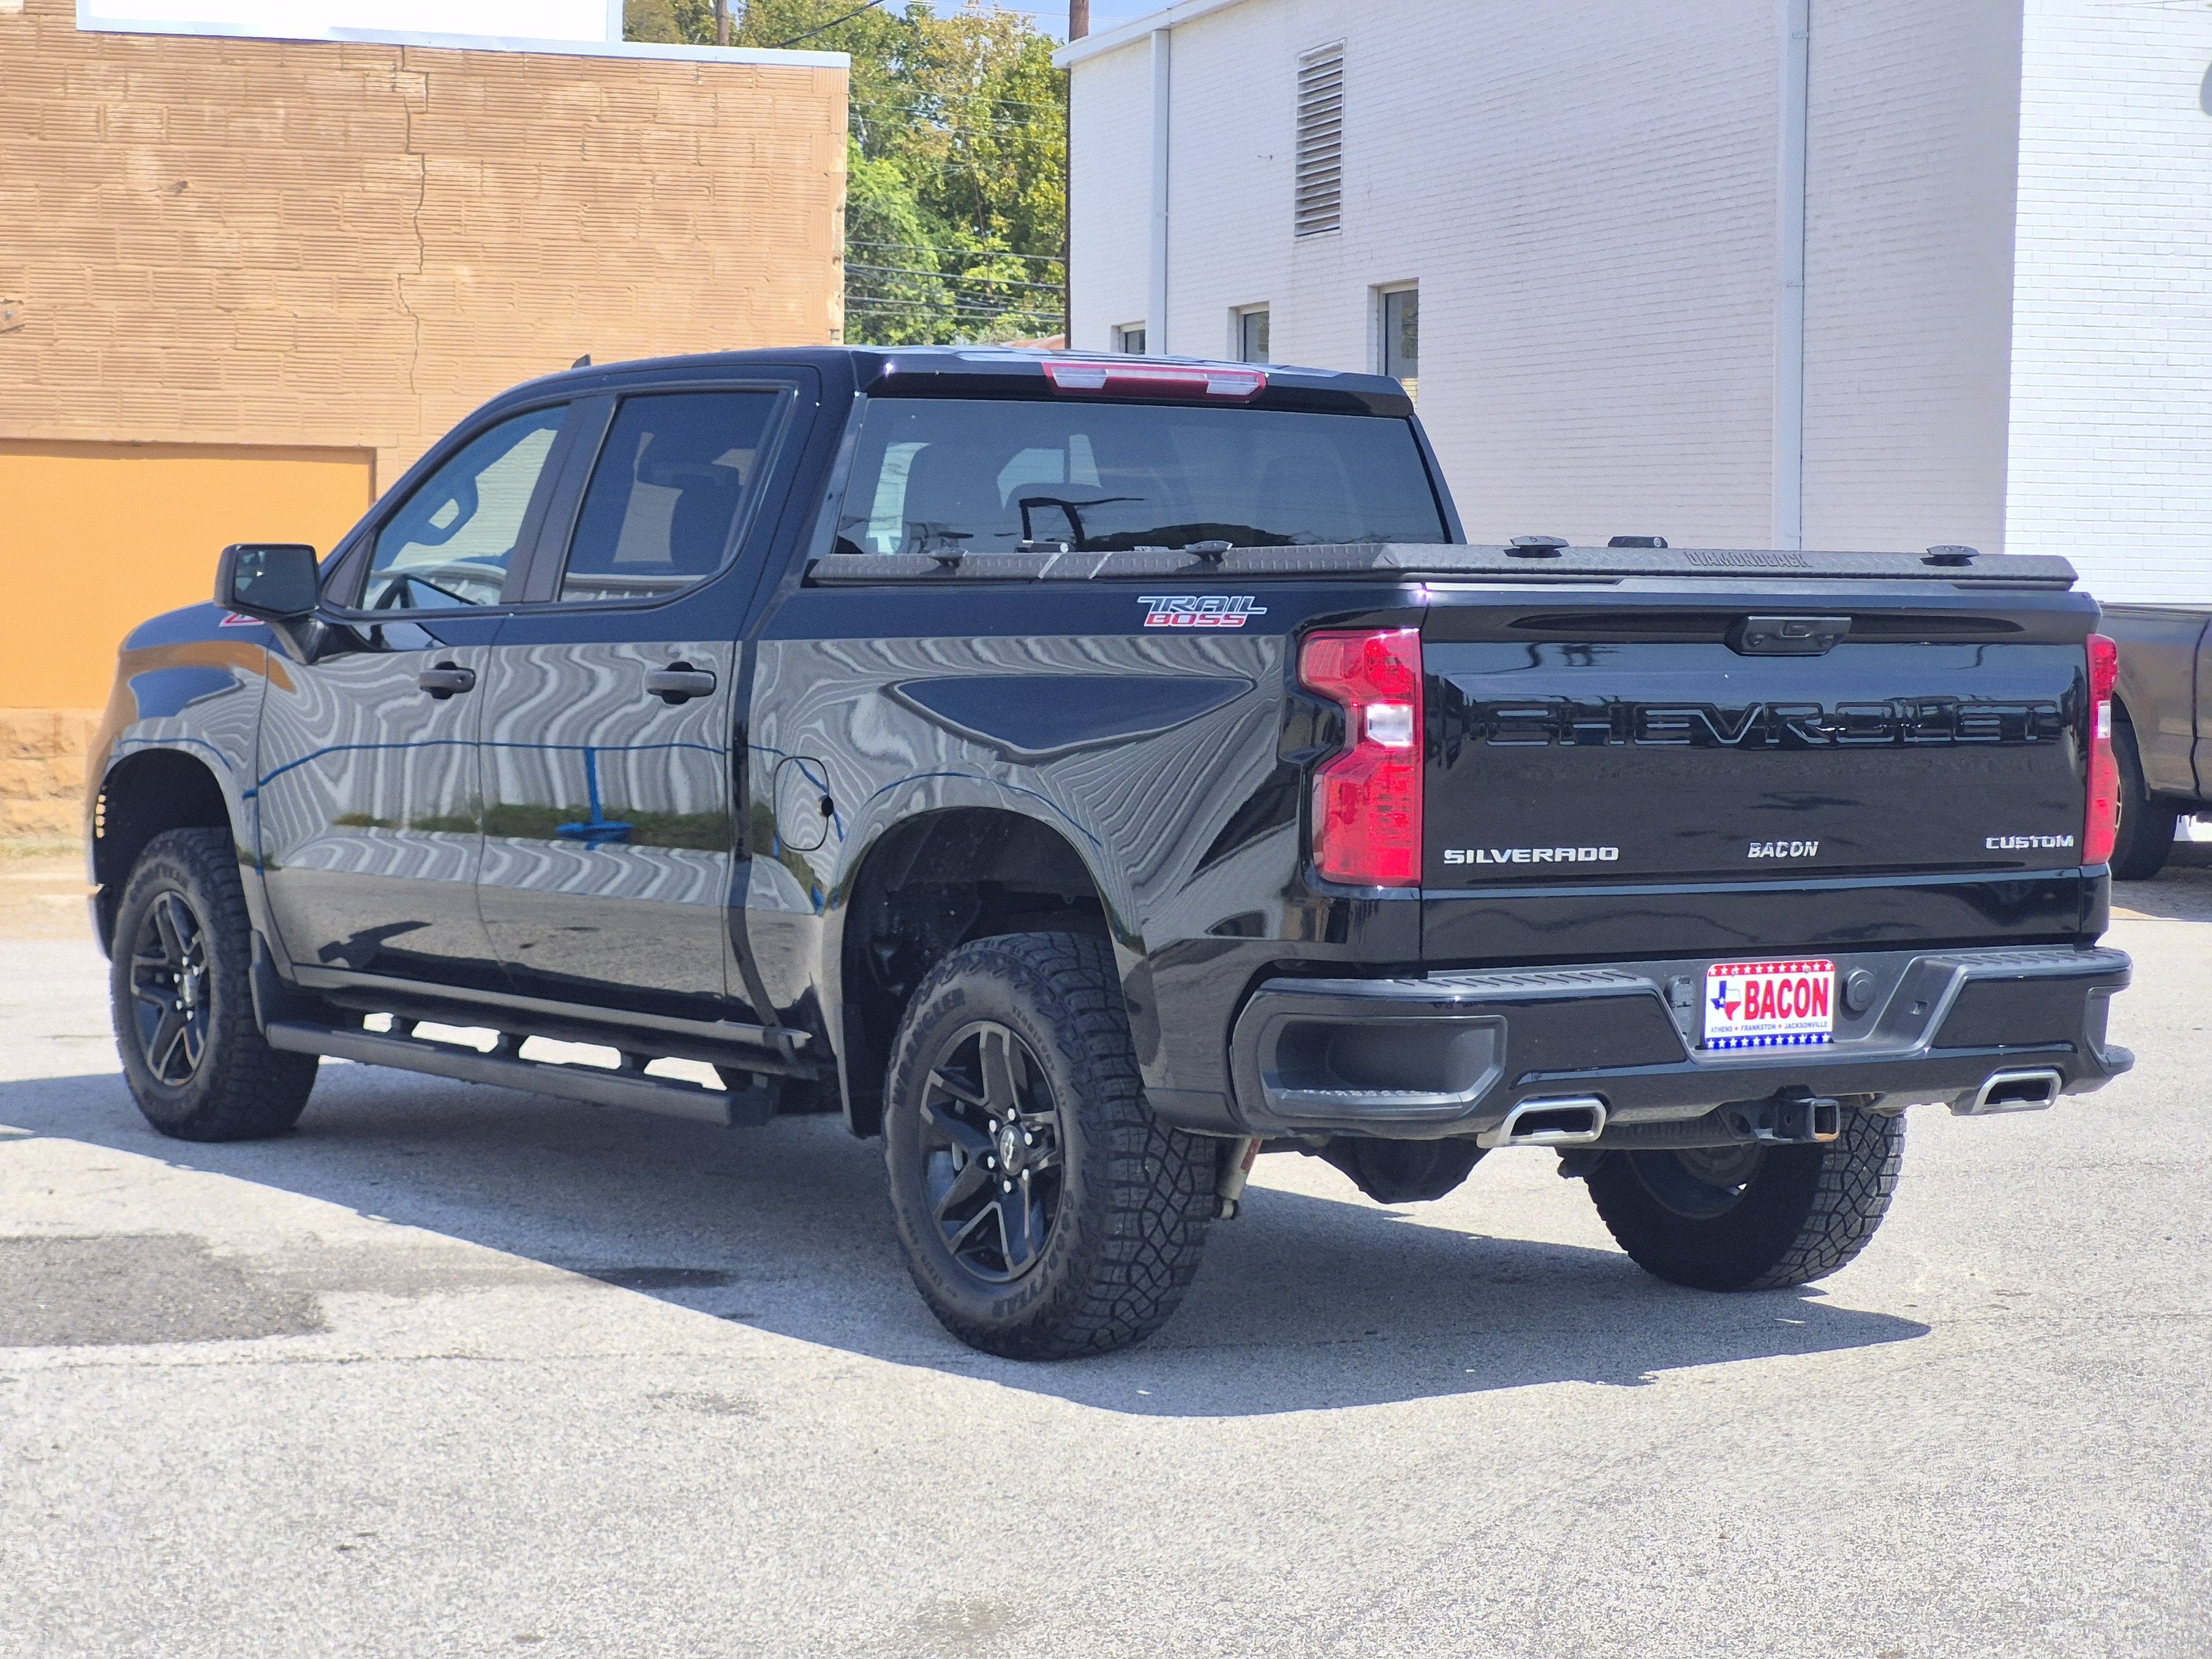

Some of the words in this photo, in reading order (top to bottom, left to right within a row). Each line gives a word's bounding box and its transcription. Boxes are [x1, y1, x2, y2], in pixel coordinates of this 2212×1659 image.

[1683, 551, 1813, 567] DIAMONDBACK
[1137, 596, 1267, 614] TRAIL
[1144, 613, 1248, 627] BOSS
[1486, 701, 2058, 746] CHEVROLET
[1747, 841, 1819, 858] BACON
[1985, 834, 2074, 849] CUSTOM
[1444, 847, 1619, 863] SILVERADO
[1744, 977, 1829, 1020] BACON
[1740, 1023, 1776, 1031] FRANKSTON
[1784, 1021, 1828, 1030] JACKSONVILLE
